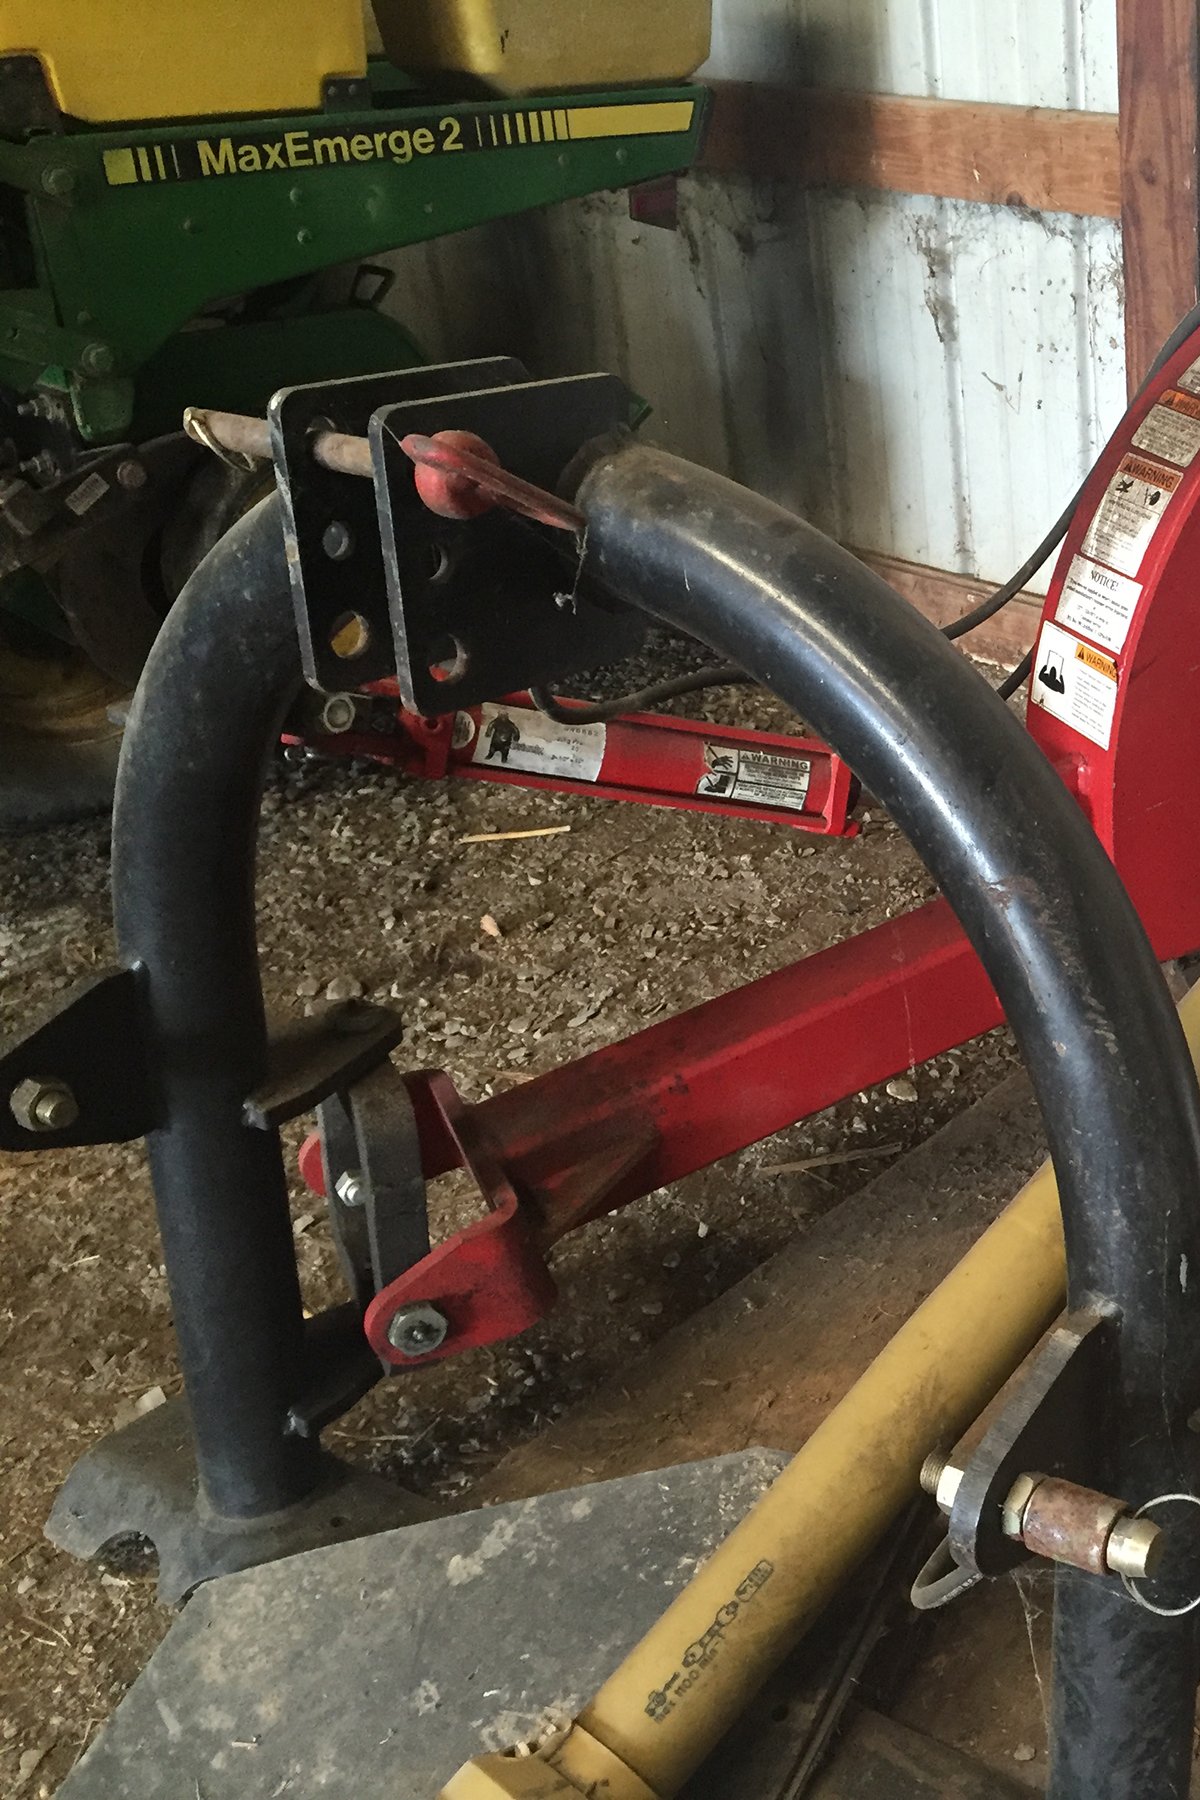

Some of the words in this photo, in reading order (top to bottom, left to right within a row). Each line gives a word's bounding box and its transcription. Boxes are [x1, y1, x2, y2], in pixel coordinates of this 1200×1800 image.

[197, 127, 435, 176] MaxEmerge
[438, 116, 464, 151] 2
[1131, 463, 1175, 489] WARNING
[1086, 653, 1117, 679] WARNING
[751, 752, 809, 770] WARNING
